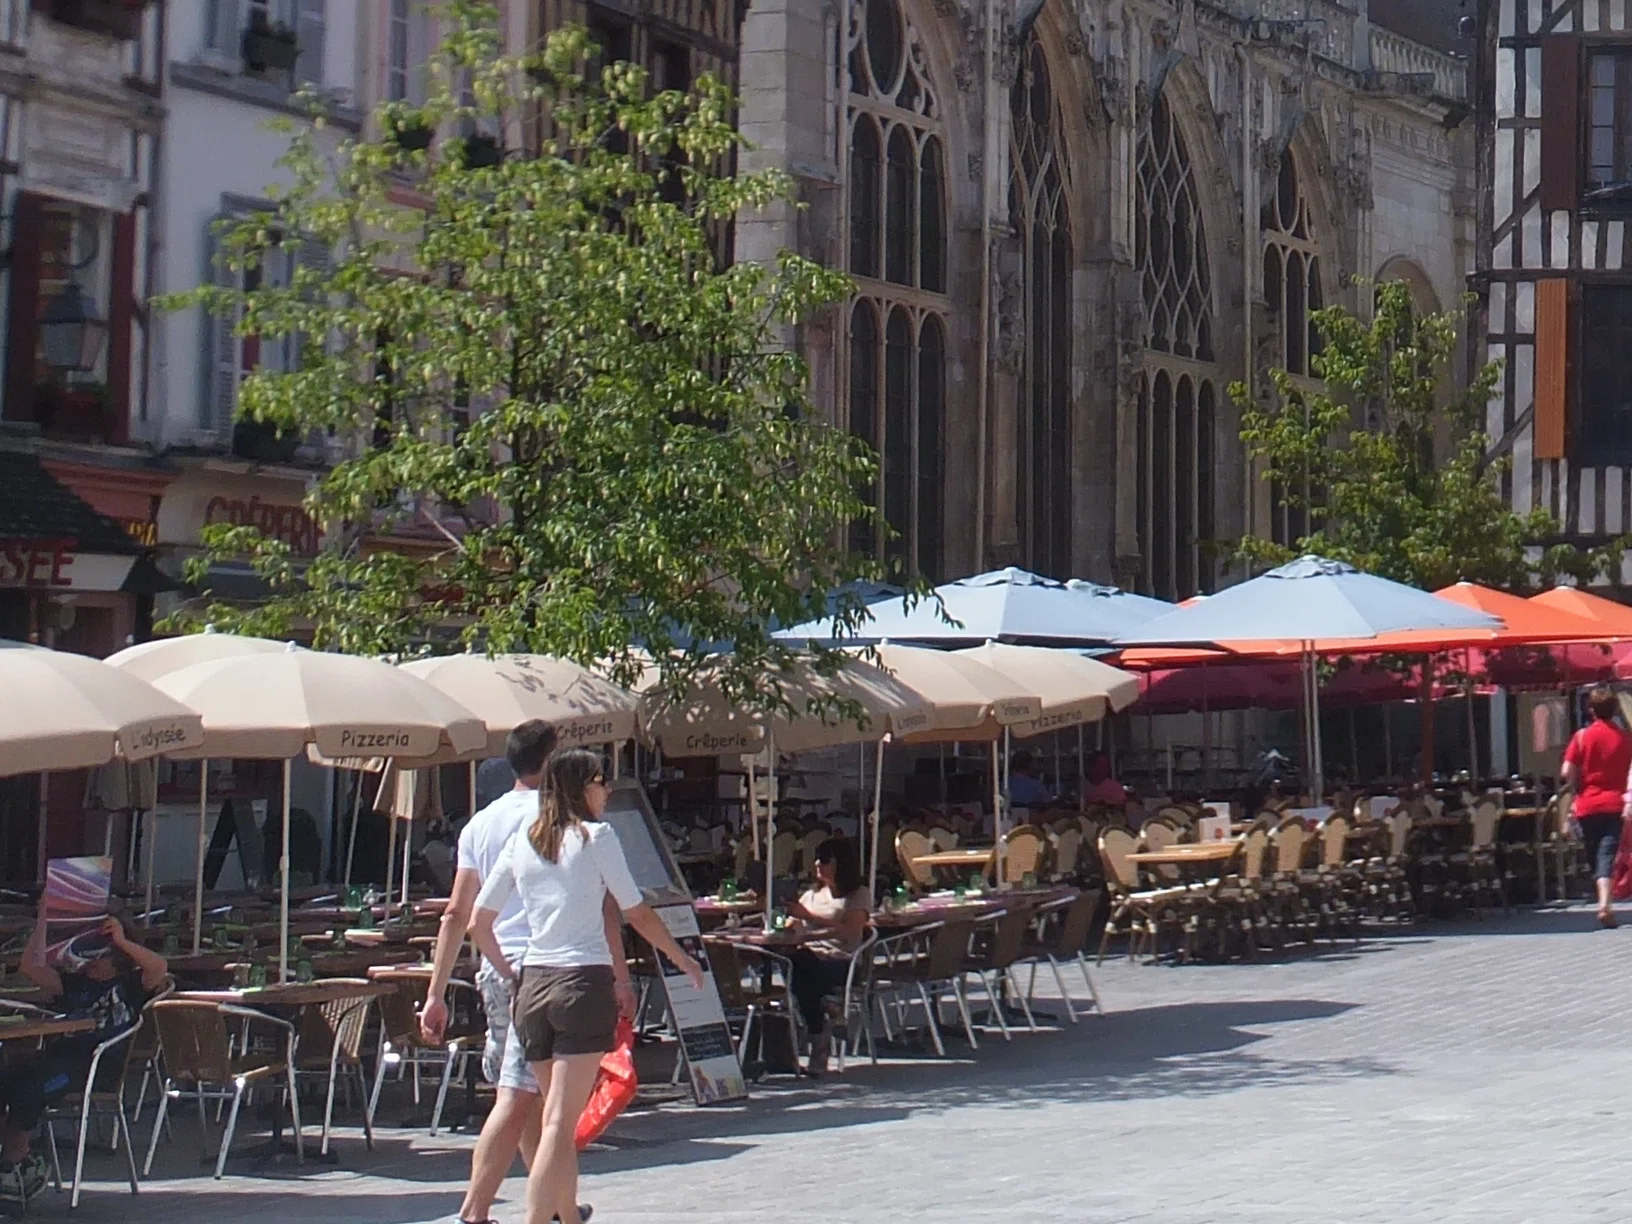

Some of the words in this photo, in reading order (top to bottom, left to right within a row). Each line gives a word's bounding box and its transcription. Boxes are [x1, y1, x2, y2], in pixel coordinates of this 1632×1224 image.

[340, 729, 410, 748] Pizzeria
[556, 718, 613, 742] Crêperie
[685, 732, 748, 750] Crêperie
